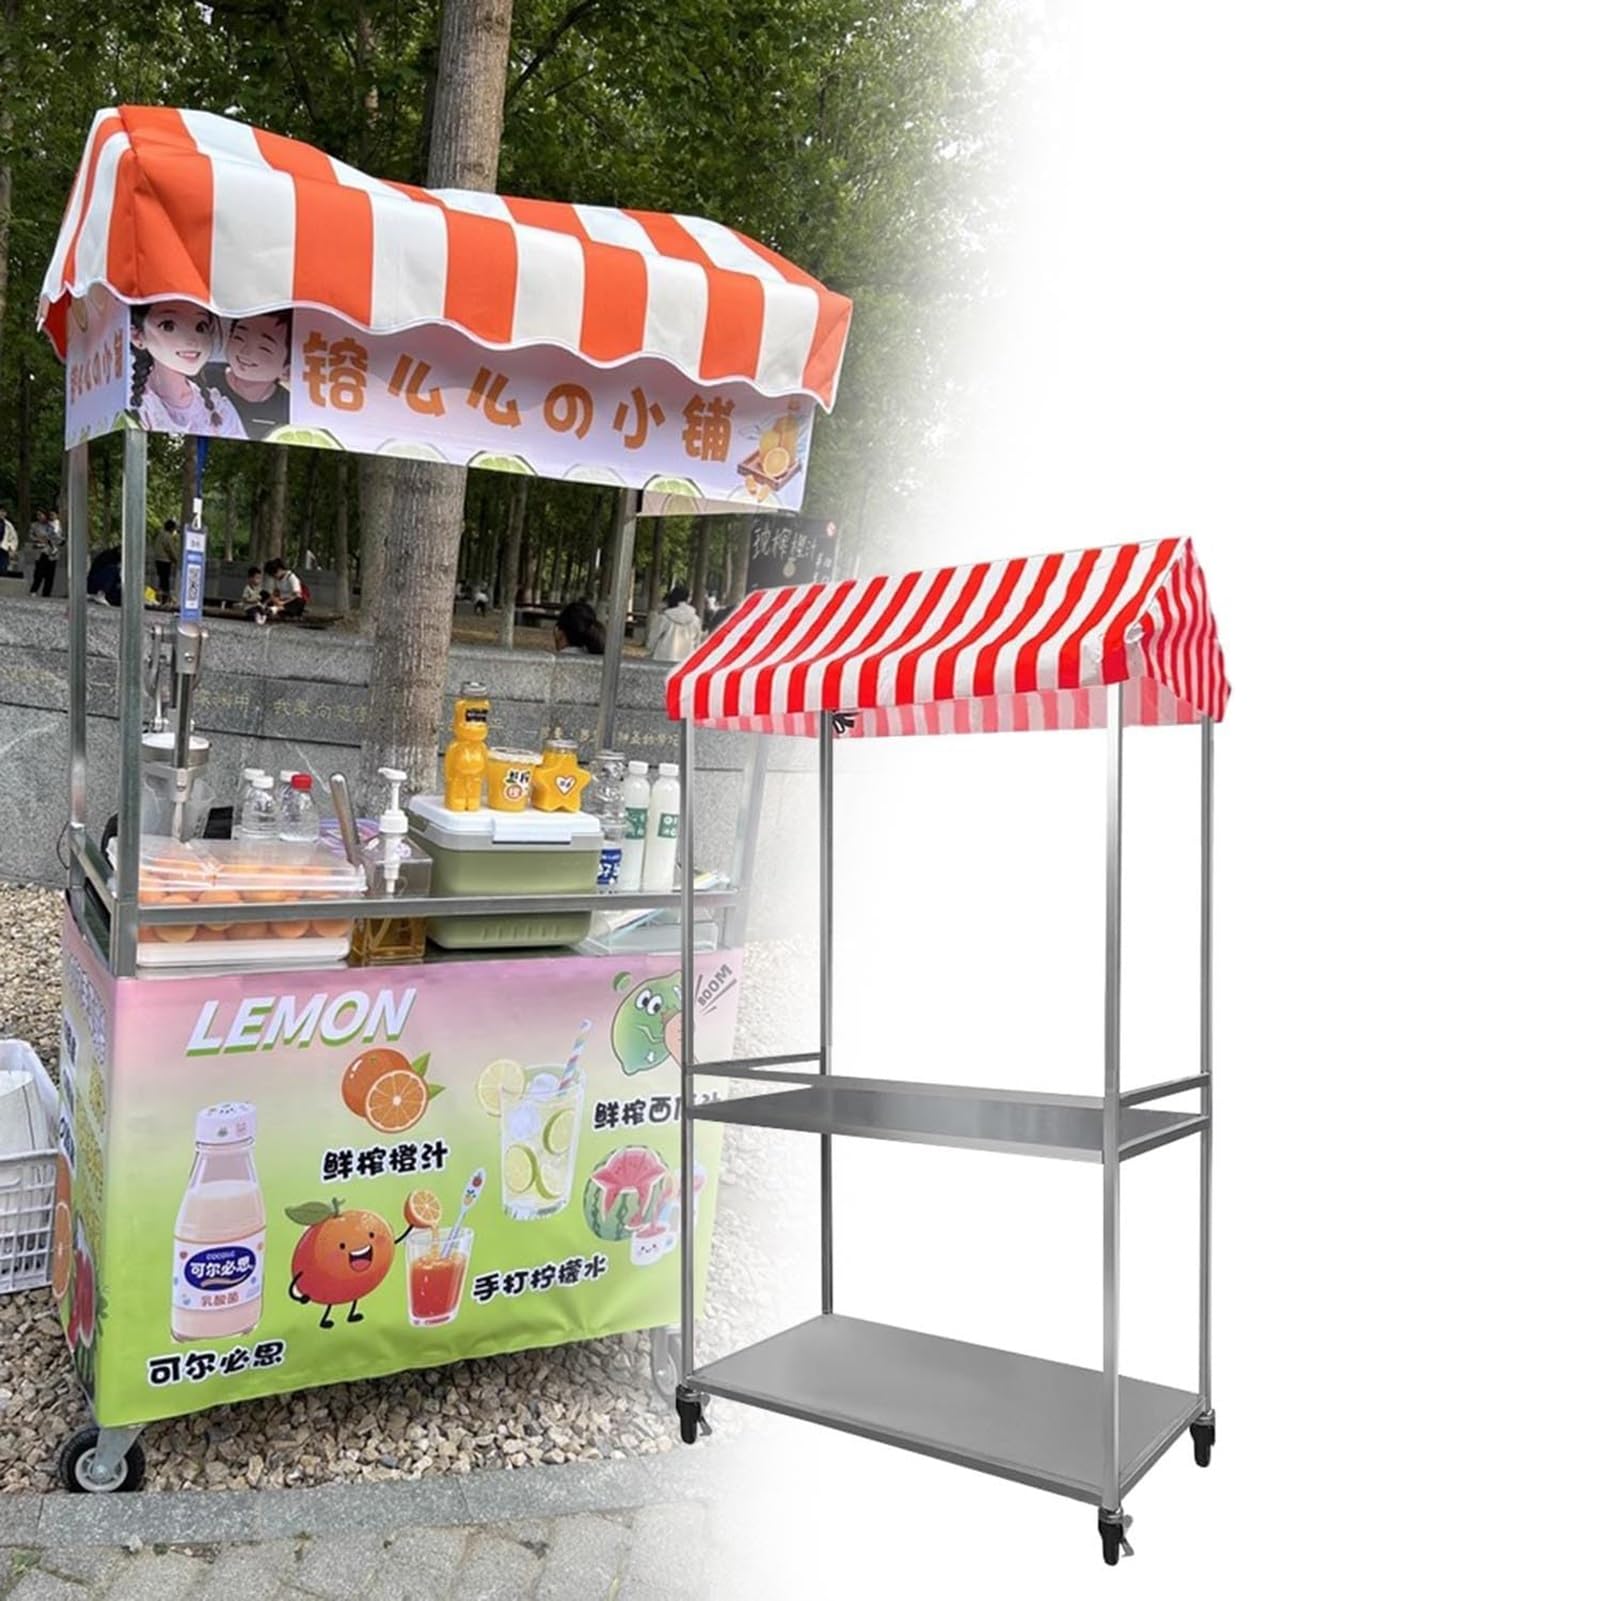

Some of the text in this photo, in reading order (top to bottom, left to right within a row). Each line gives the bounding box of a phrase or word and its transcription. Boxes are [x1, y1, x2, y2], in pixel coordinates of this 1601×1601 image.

[697, 963, 733, 1007] BOOM
[186, 988, 416, 1057] LEMON
[322, 1144, 448, 1180] 鲜榨橙汁
[190, 1255, 254, 1279] 可尔必思
[473, 1255, 607, 1301] 手打柠檬水
[201, 1291, 240, 1307] 乳酸菌
[149, 1342, 284, 1385] 可尔必思
